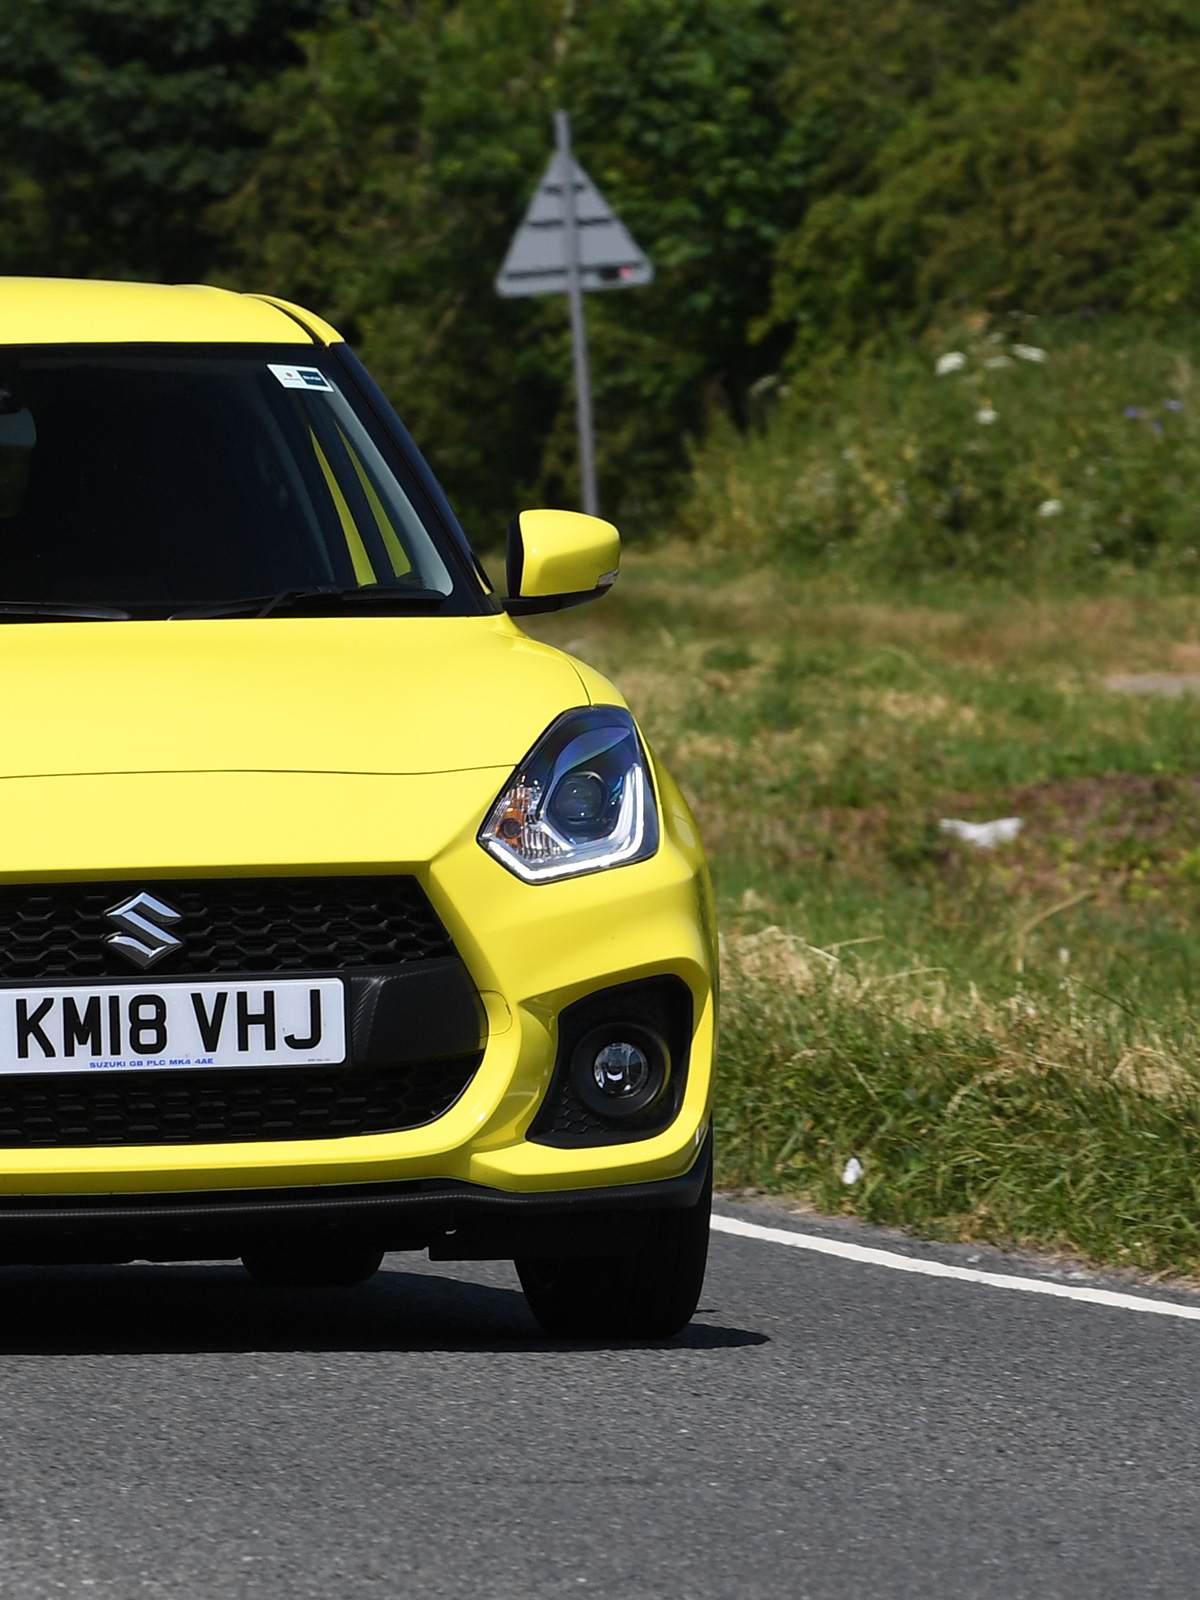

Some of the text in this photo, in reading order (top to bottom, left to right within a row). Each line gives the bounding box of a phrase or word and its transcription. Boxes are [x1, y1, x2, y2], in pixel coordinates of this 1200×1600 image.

[15, 989, 322, 1059] KM18 VHJ
[89, 1060, 126, 1068] SUZUKI
[194, 1057, 214, 1065] 4AE
